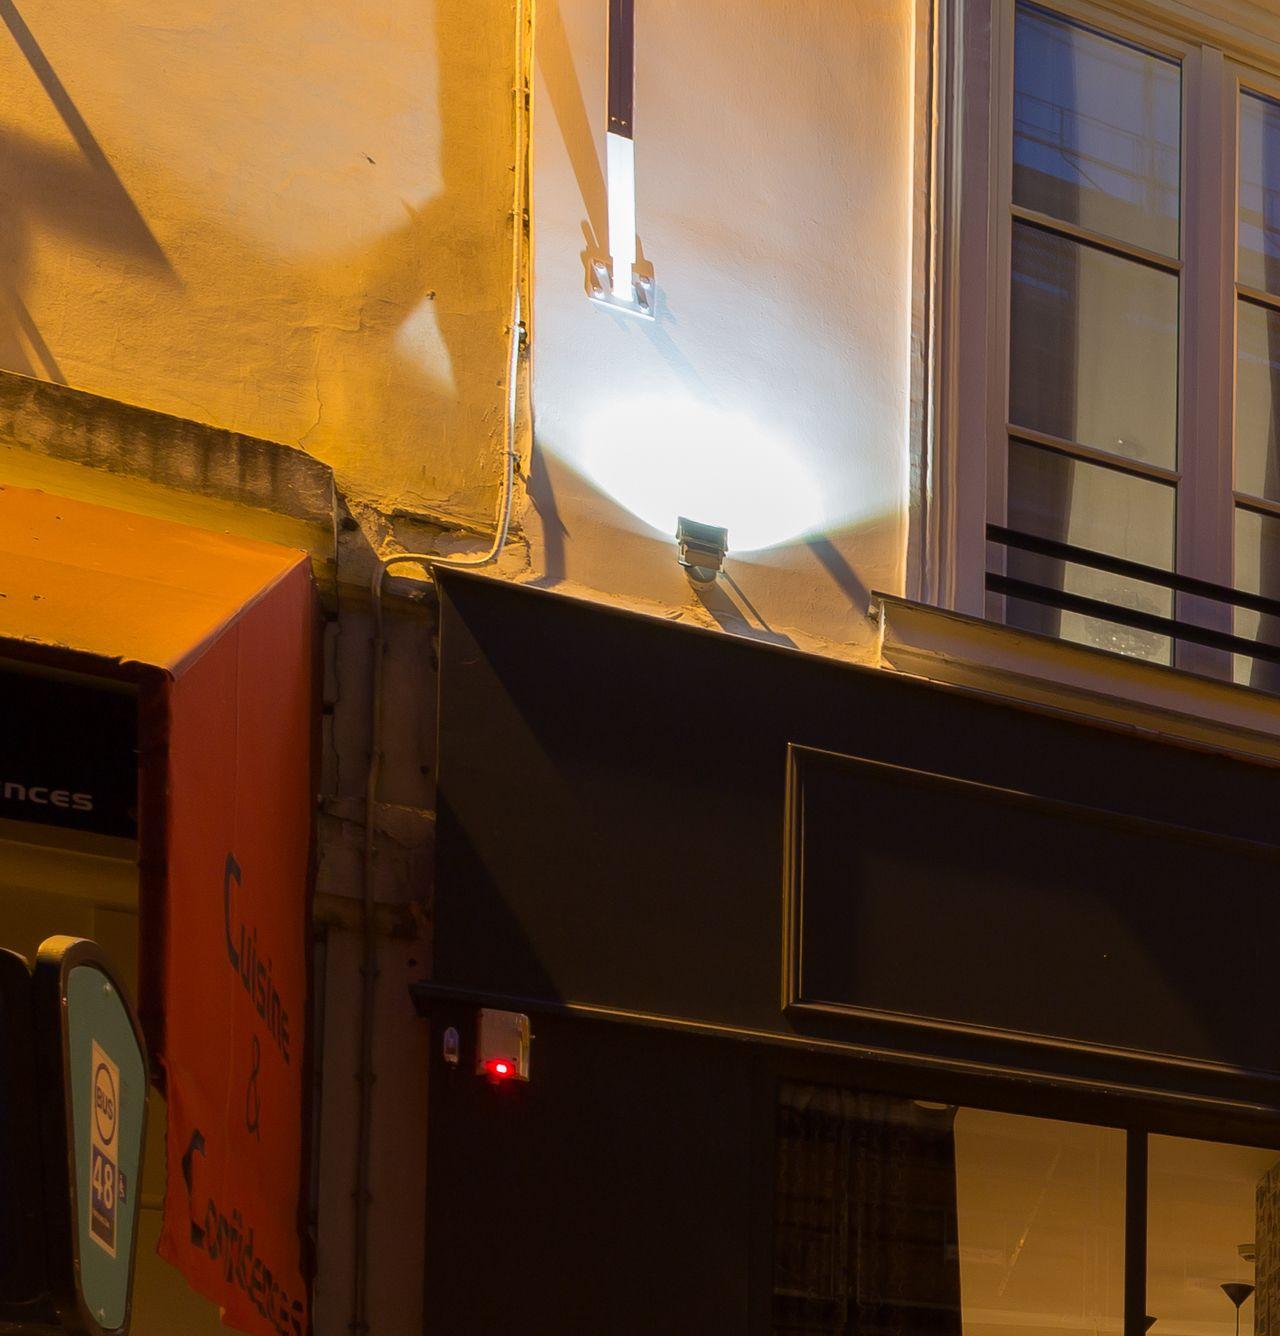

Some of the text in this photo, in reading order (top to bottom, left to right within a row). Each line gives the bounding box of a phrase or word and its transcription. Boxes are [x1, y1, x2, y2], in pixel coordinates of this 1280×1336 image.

[224, 851, 290, 1066] Cuisine
[95, 1085, 114, 1121] BUS
[92, 1155, 114, 1210] 48
